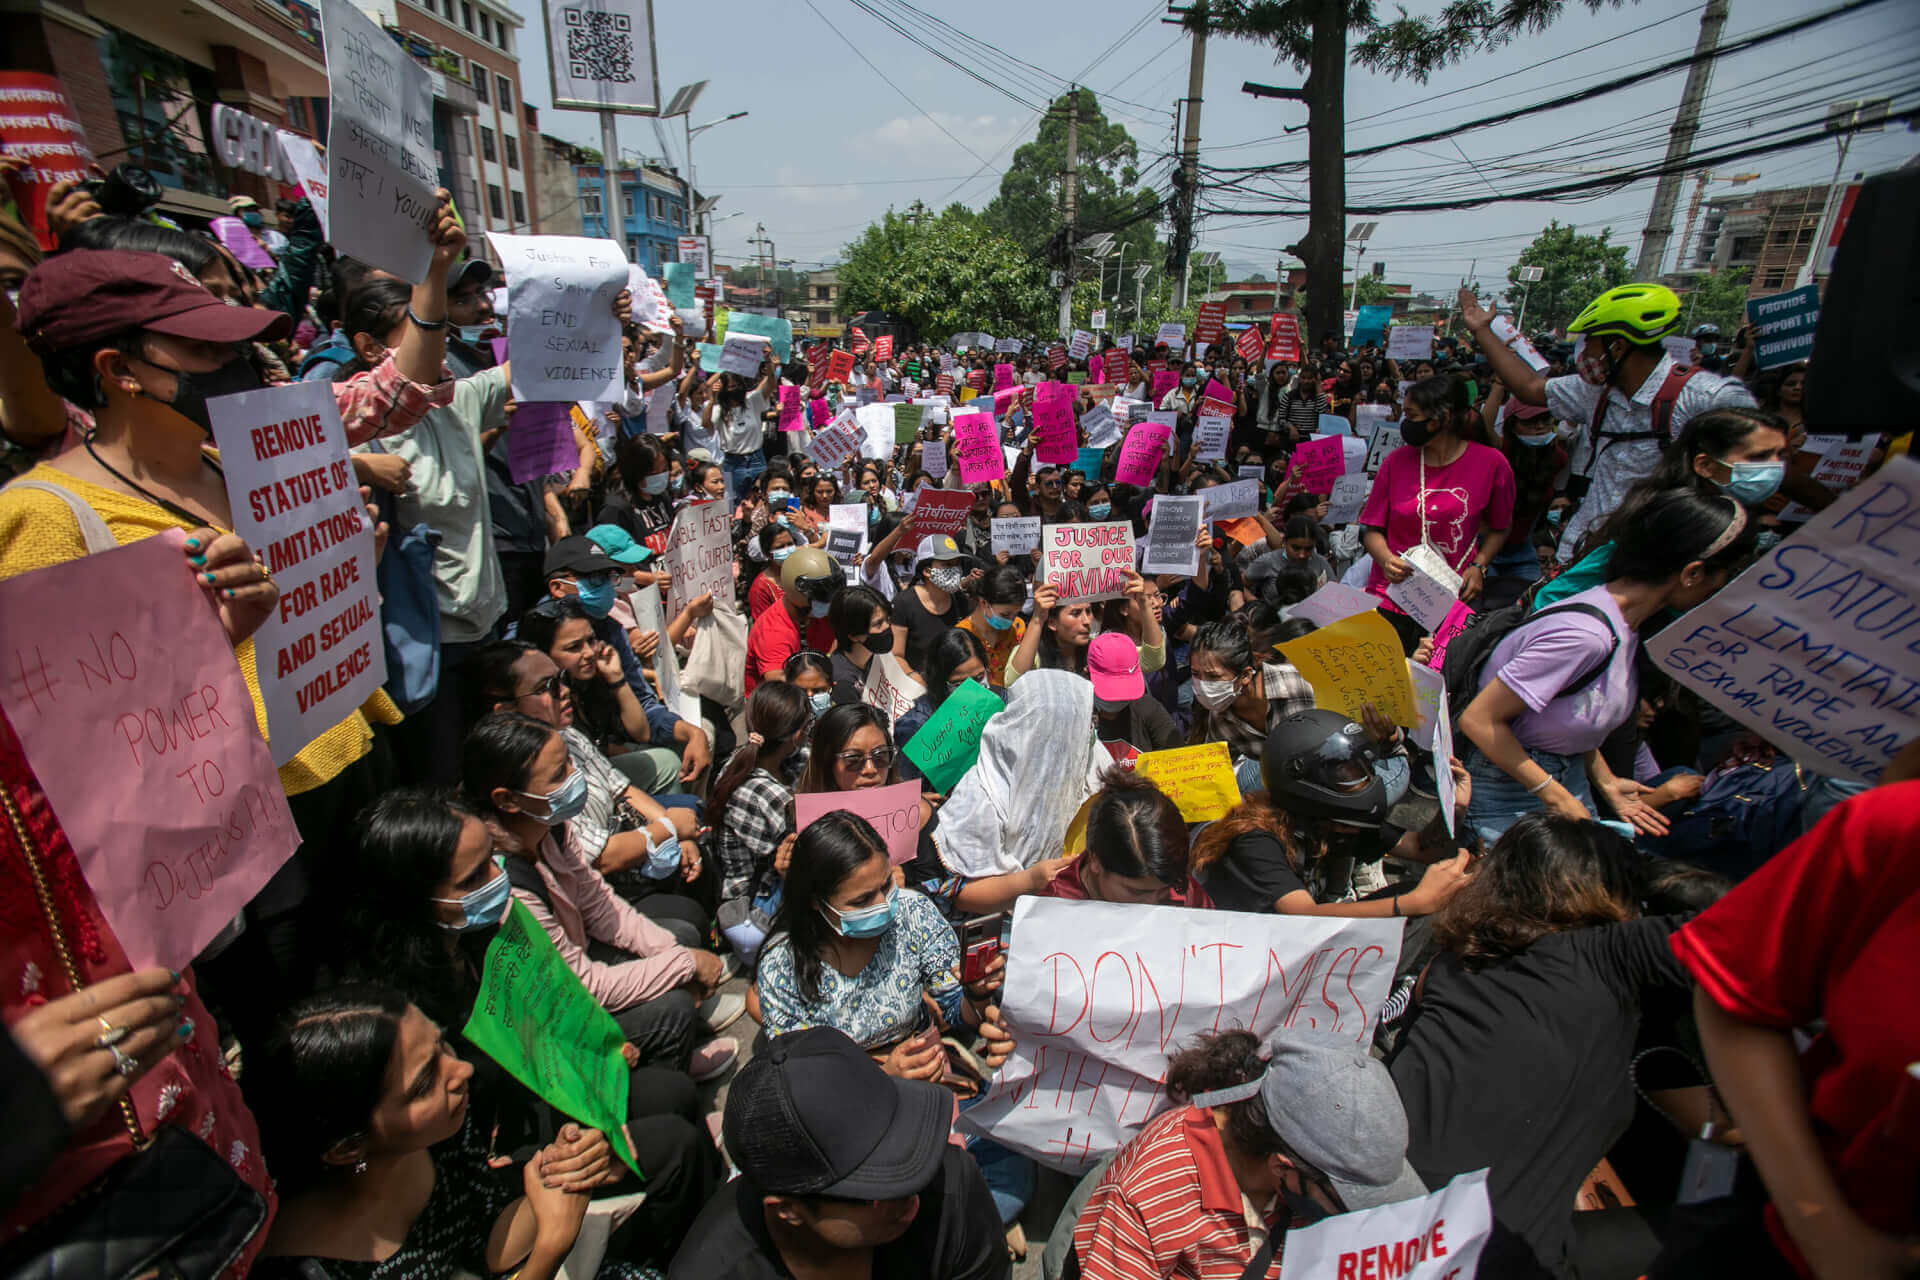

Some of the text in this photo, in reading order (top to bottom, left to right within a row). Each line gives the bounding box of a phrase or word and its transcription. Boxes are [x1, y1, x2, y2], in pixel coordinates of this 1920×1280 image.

[542, 310, 577, 329] END
[1758, 294, 1807, 316] PROVIDE
[544, 336, 604, 354] SEXUAL
[544, 366, 618, 381] VIOLENCE
[250, 414, 326, 462] REMOVE
[249, 459, 348, 523] STATUTE OF
[256, 505, 363, 576] LIMITATIONS
[1048, 547, 1133, 569] FOR OUR
[280, 556, 360, 624] FOR RAPE
[277, 595, 373, 680] AND SEXUAL
[296, 641, 371, 714] VIOLENCE
[1663, 647, 1769, 718] SEXUAL
[1683, 624, 1748, 664] FOR
[1756, 662, 1856, 722] RAPE
[113, 683, 230, 767] POWER
[176, 759, 226, 804] TO
[1032, 942, 1244, 1055] DON'T
[1337, 1219, 1448, 1280] REMOVE
